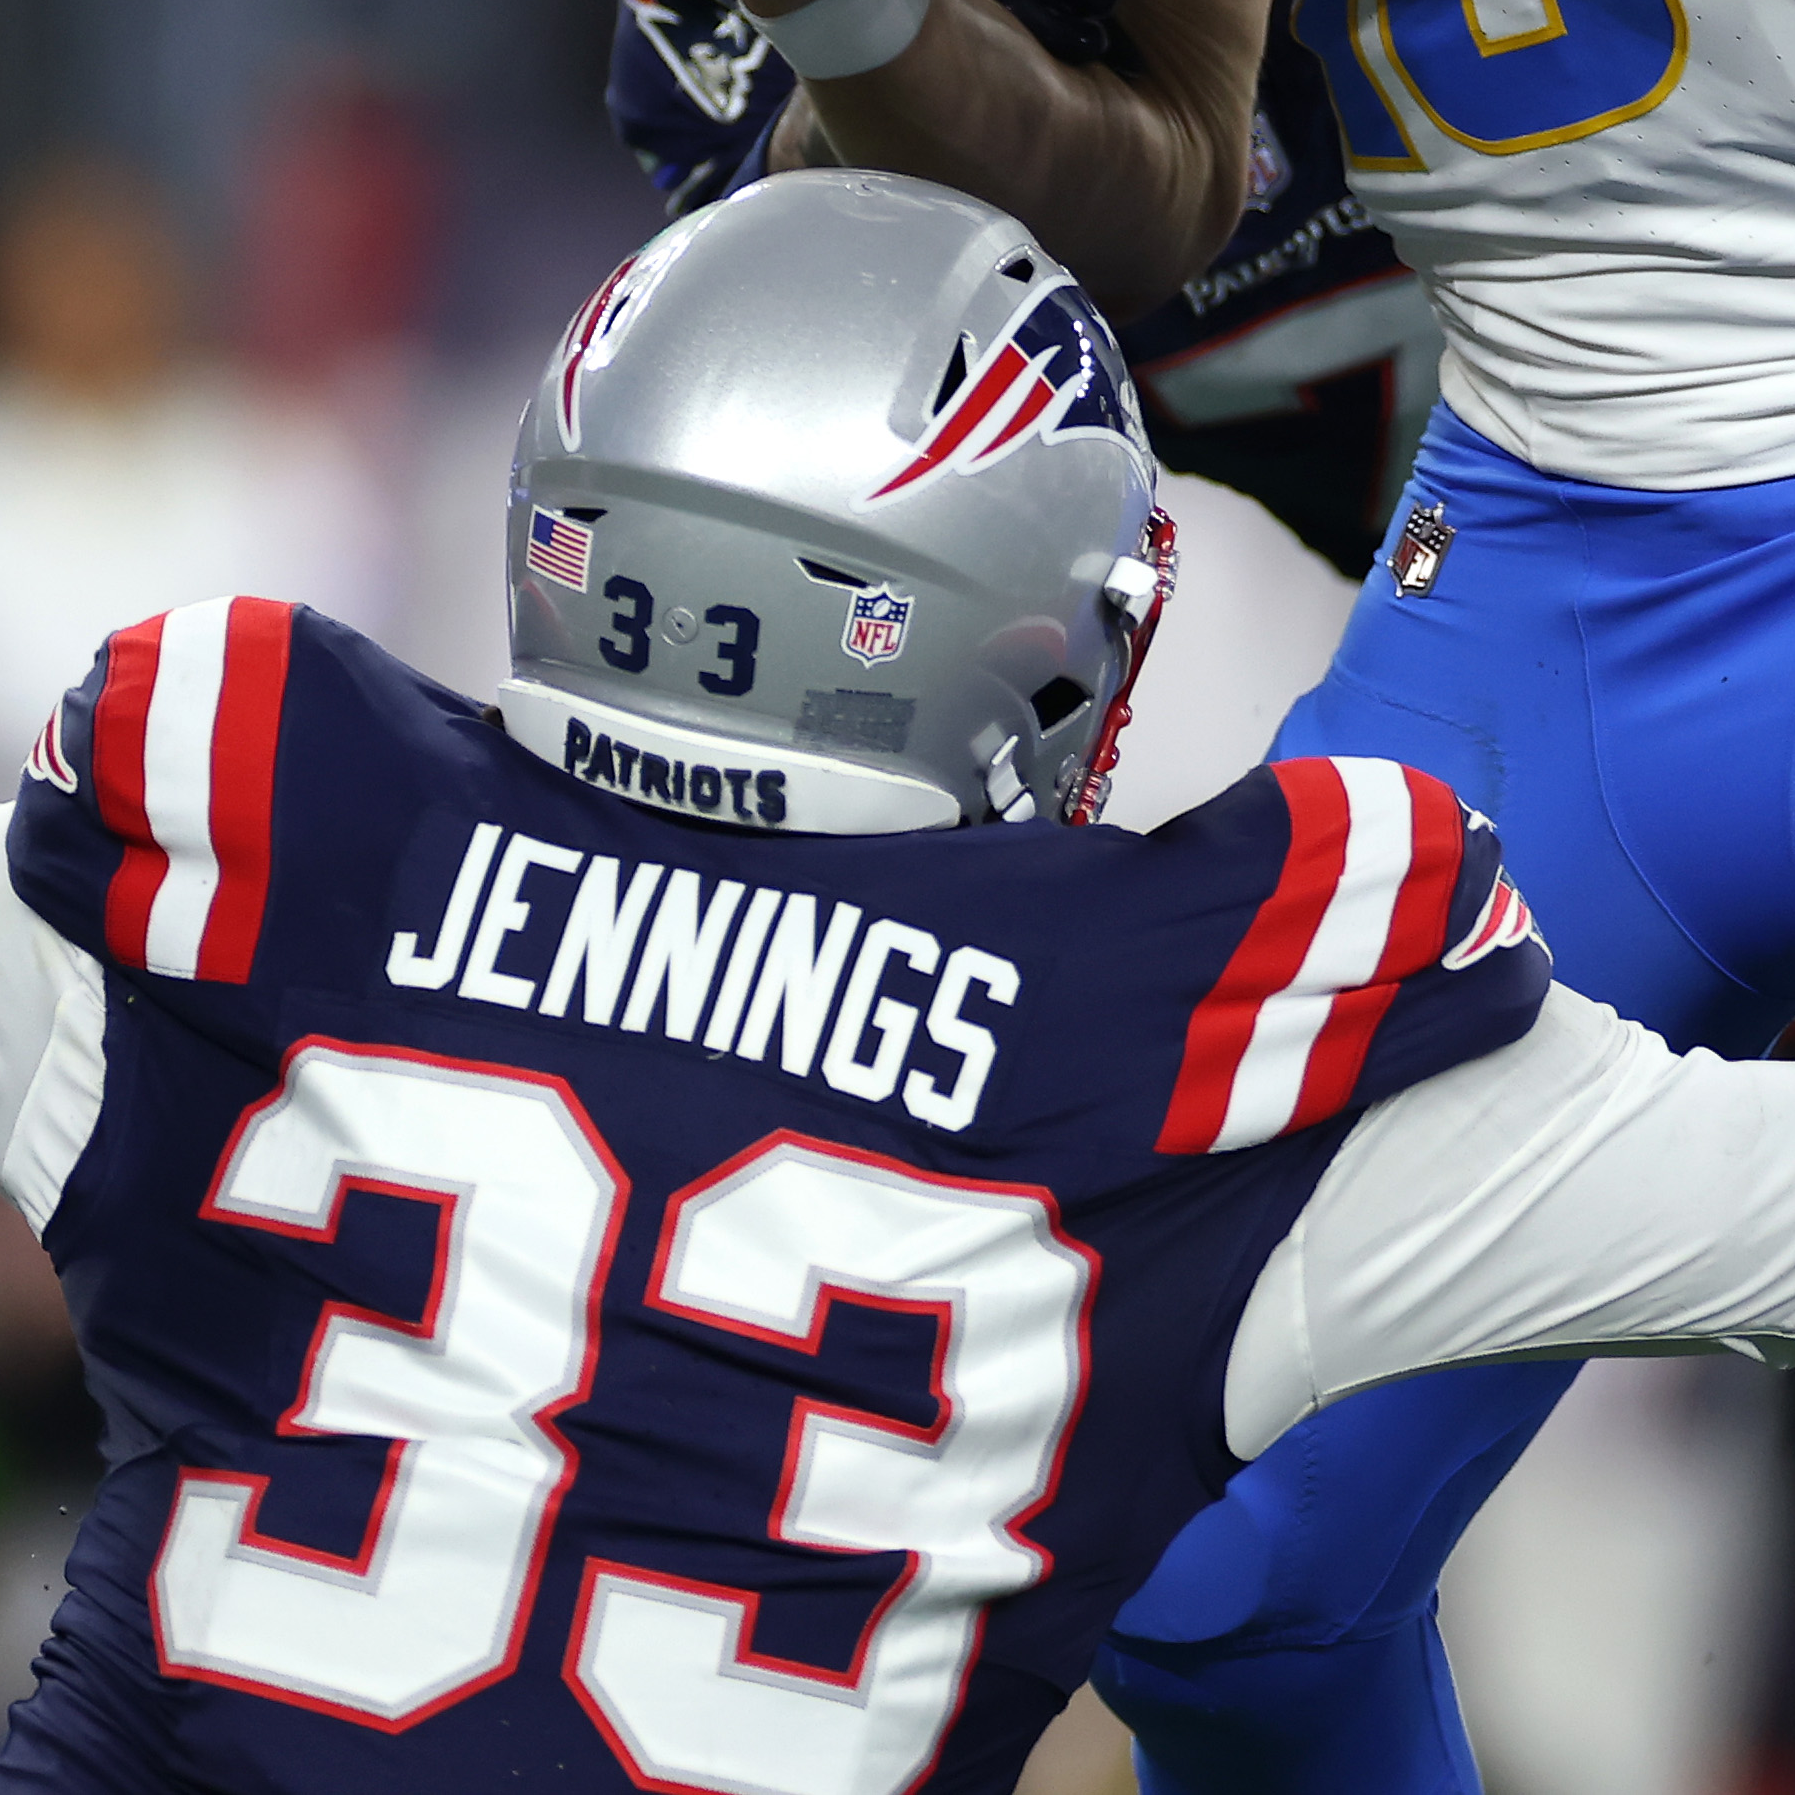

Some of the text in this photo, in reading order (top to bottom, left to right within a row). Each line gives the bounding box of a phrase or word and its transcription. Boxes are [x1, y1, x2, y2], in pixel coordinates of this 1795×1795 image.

[598, 574, 761, 697] 33
[851, 619, 896, 654] NFL
[564, 716, 787, 824] PATRIOTS
[385, 822, 1021, 1132] JENNINGS
[150, 1033, 1103, 1795] 33
